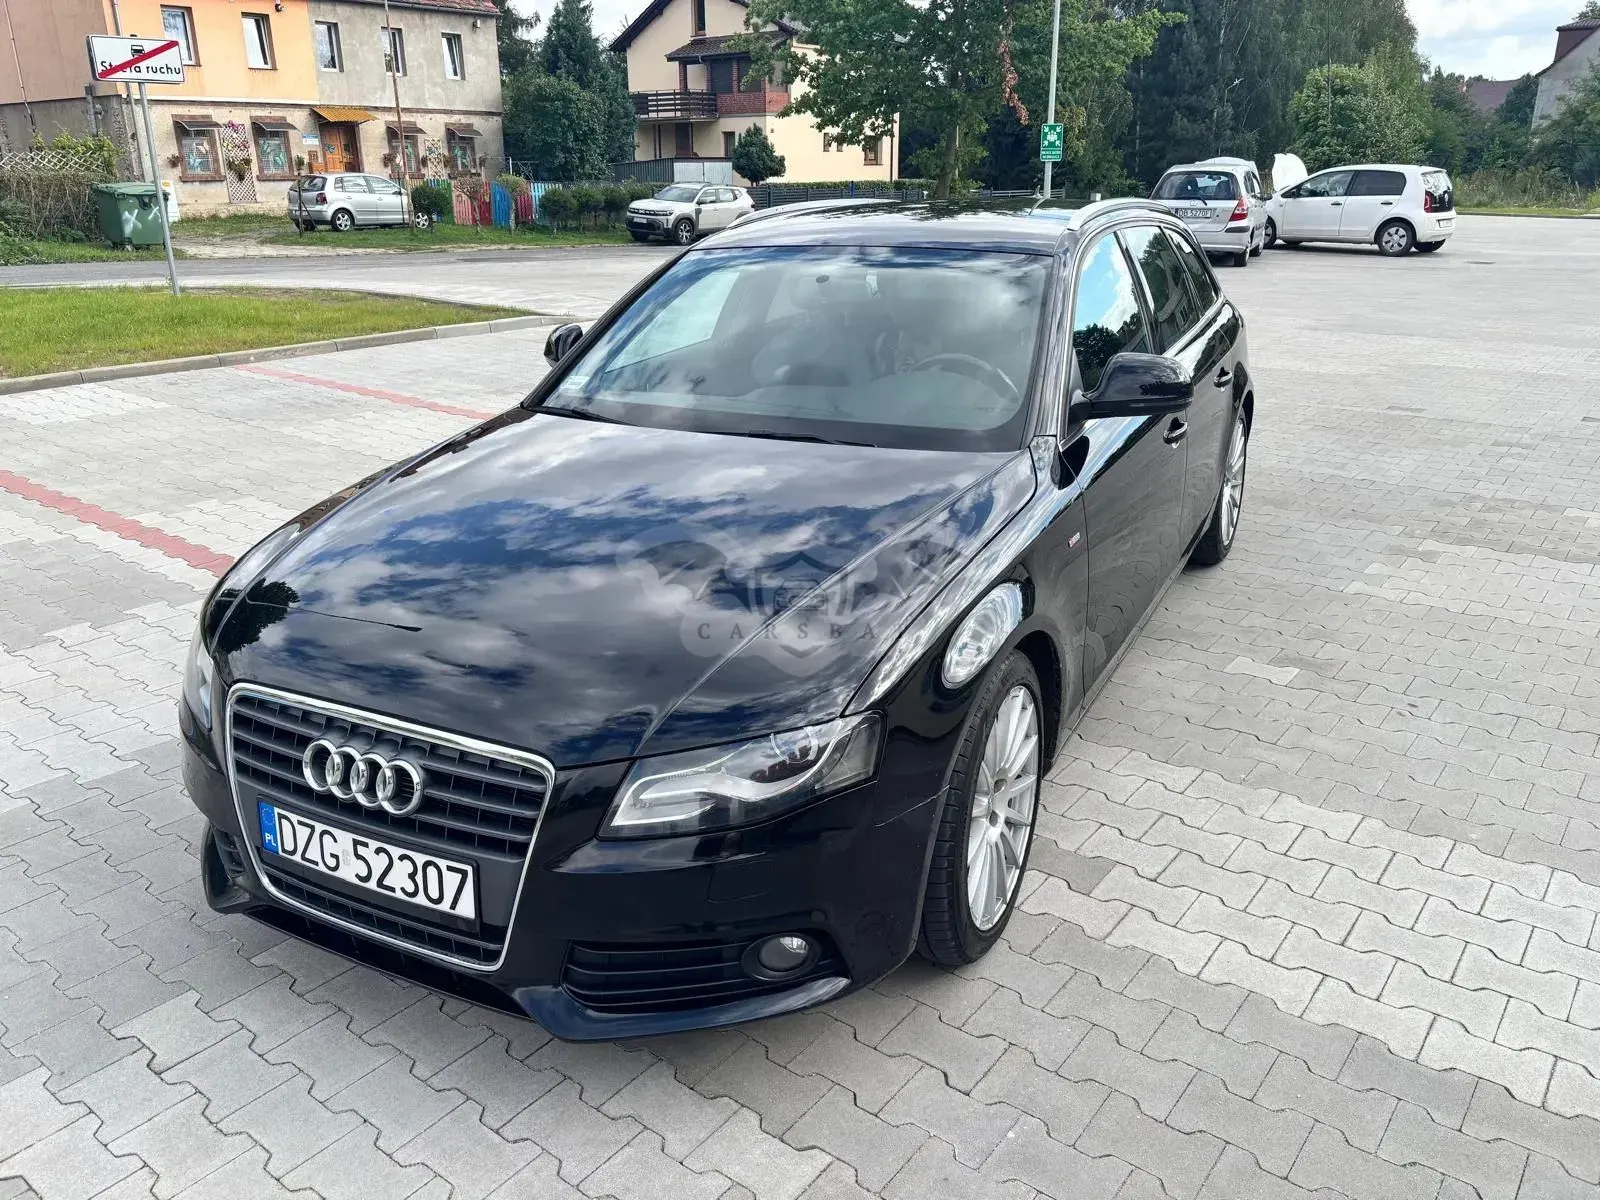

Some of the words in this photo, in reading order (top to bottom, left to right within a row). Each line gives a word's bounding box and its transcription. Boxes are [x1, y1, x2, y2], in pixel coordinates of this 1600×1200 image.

[146, 64, 181, 75] ruchu
[265, 832, 277, 847] PL
[277, 812, 341, 872] DZG
[352, 838, 469, 911] 52307
